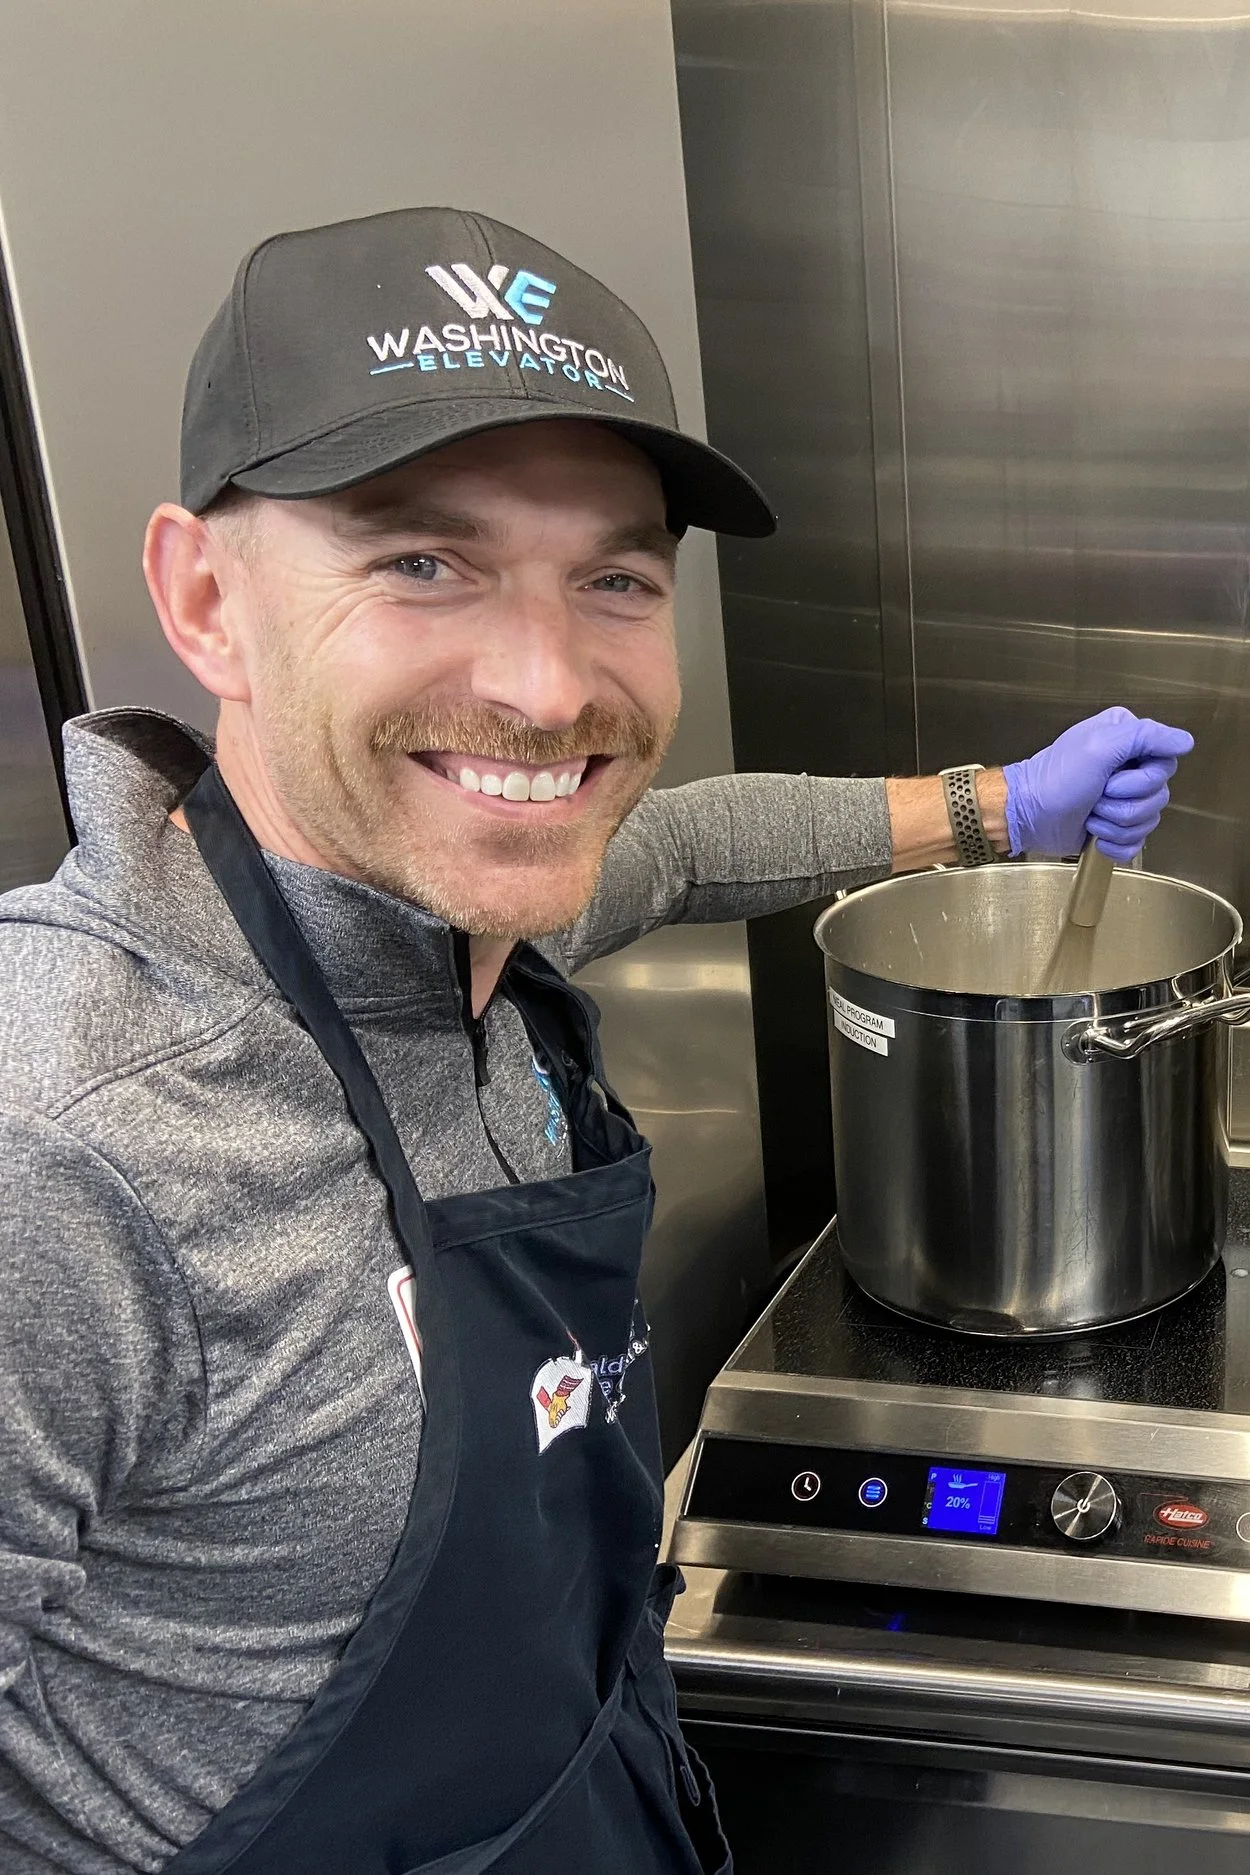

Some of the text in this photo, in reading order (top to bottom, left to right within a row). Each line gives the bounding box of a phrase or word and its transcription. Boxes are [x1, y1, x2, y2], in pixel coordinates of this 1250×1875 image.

[367, 324, 630, 390] WASHINGTON
[417, 351, 604, 391] ELEVATOR
[847, 1005, 884, 1030] PROGRAM
[840, 1020, 877, 1048] INDUCTION
[945, 1496, 970, 1509] 20%
[922, 1517, 928, 1525] S
[1160, 1507, 1204, 1524] Hatco
[1144, 1534, 1211, 1549] RAPIDE CUISINE
